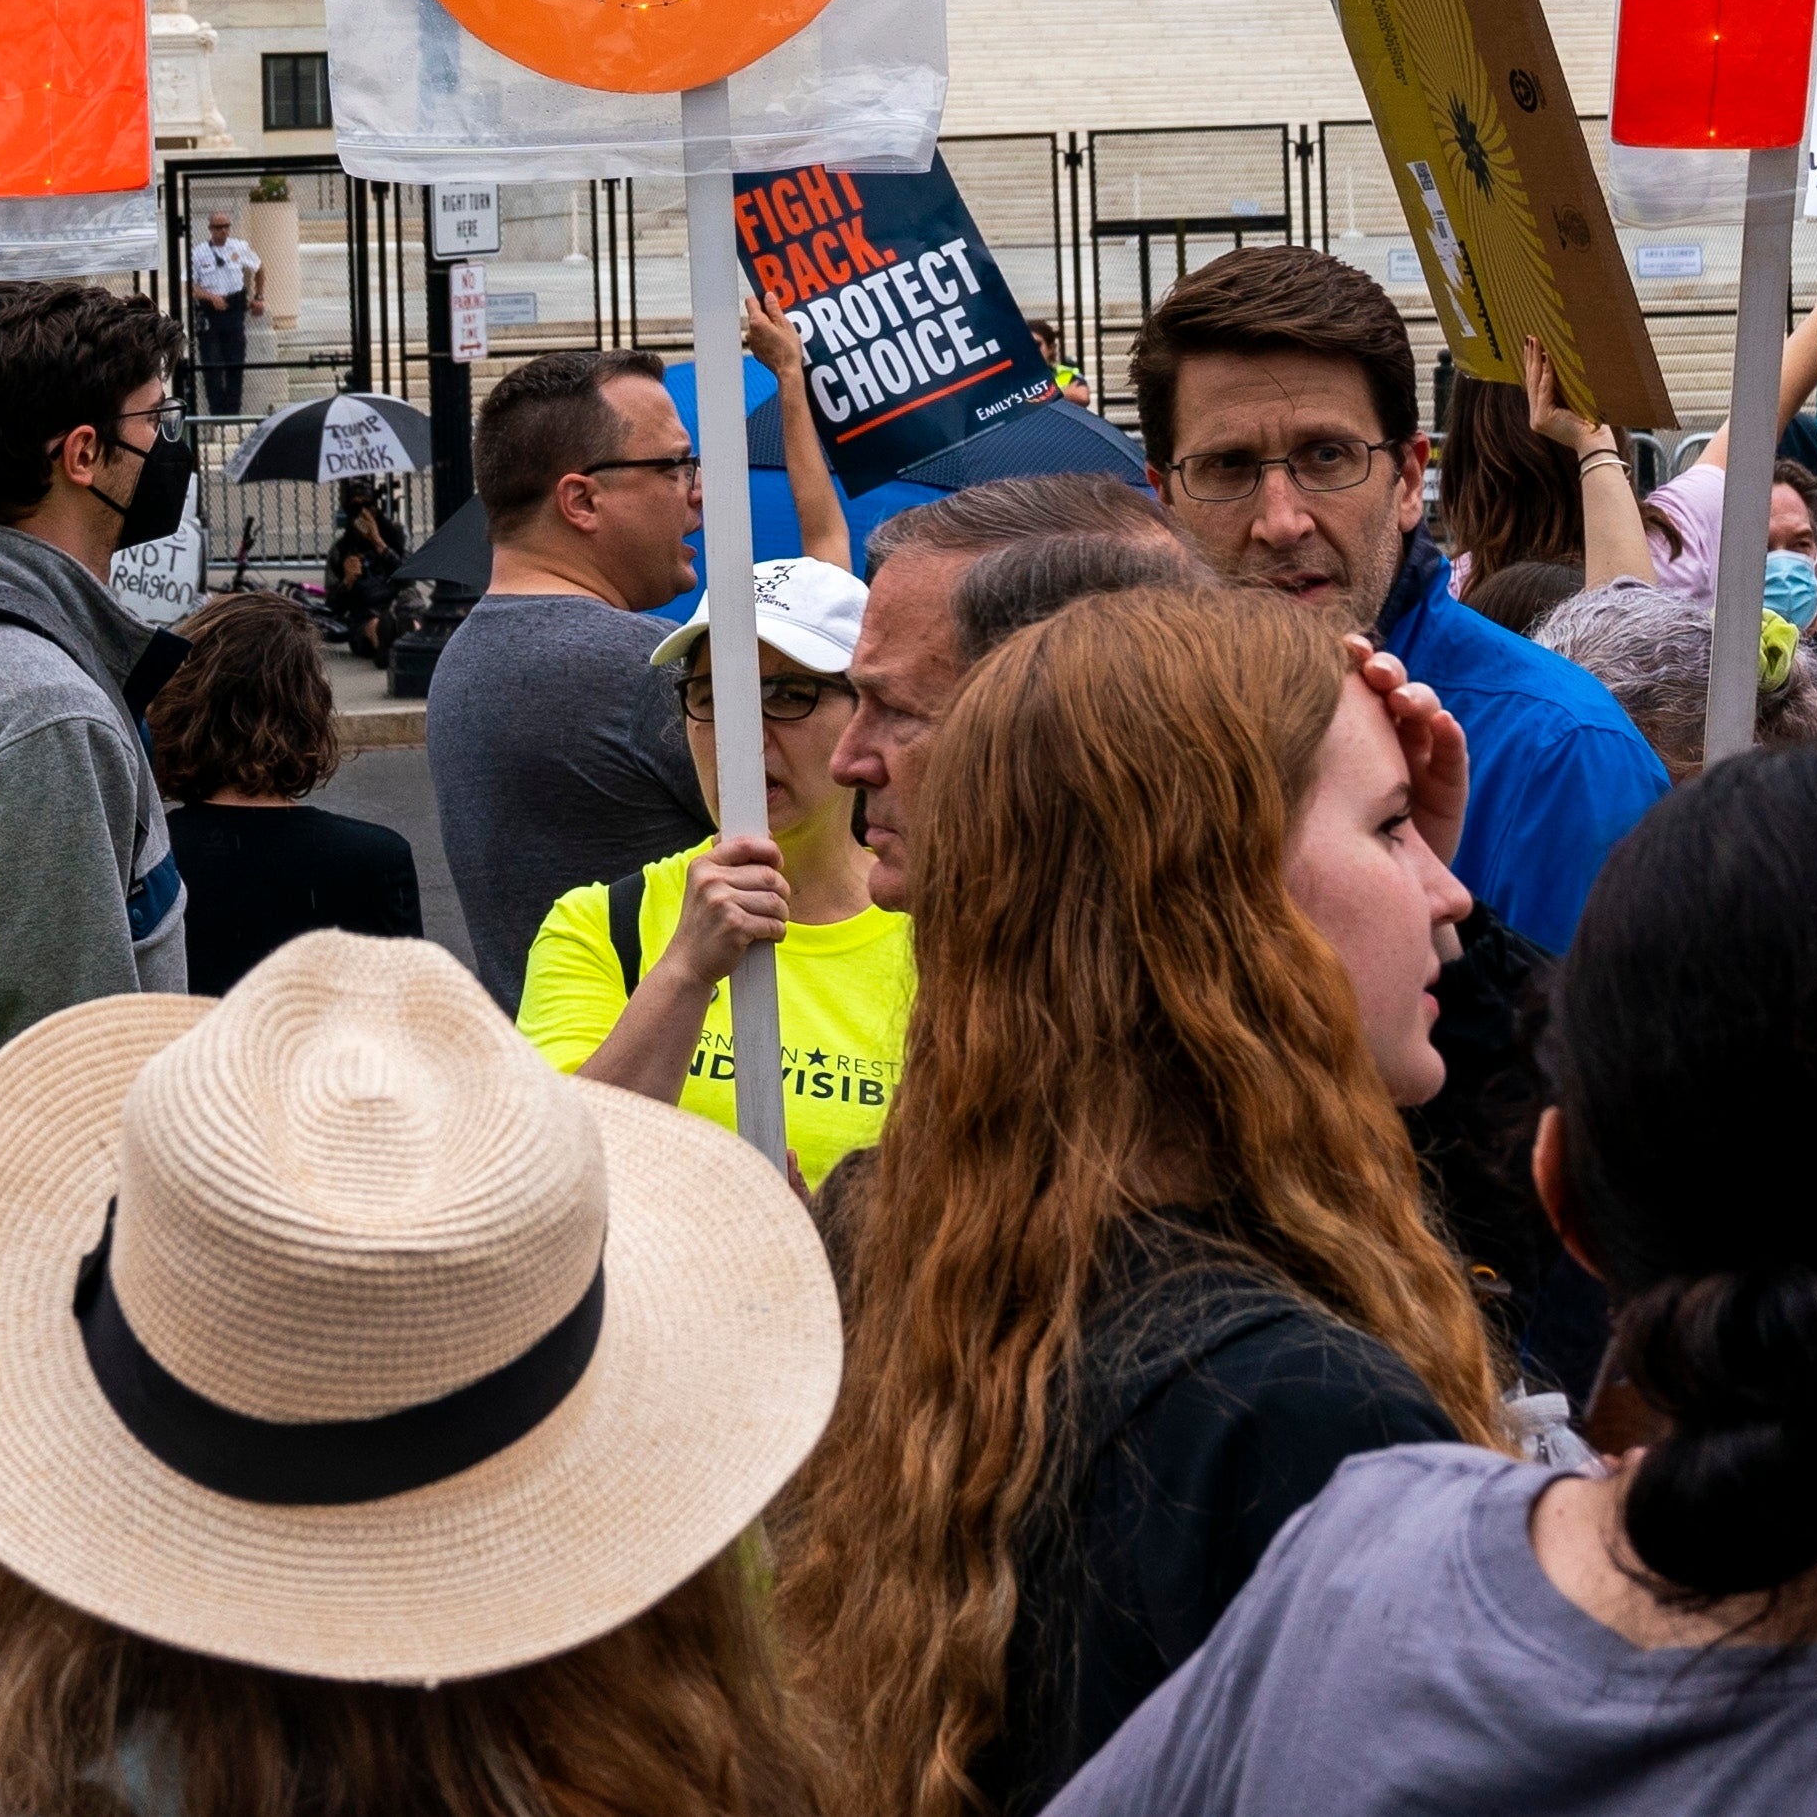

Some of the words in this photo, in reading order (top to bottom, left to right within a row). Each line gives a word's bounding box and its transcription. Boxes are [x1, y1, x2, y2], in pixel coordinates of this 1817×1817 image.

[734, 164, 863, 253] FIGHT
[752, 216, 898, 310] BACK.
[784, 237, 982, 366] PROTECT
[809, 305, 1002, 424] CHOICE.
[976, 392, 1023, 422] EMILY'S
[1021, 379, 1050, 400] LIST
[112, 564, 194, 605] Religion
[122, 543, 187, 573] NOT
